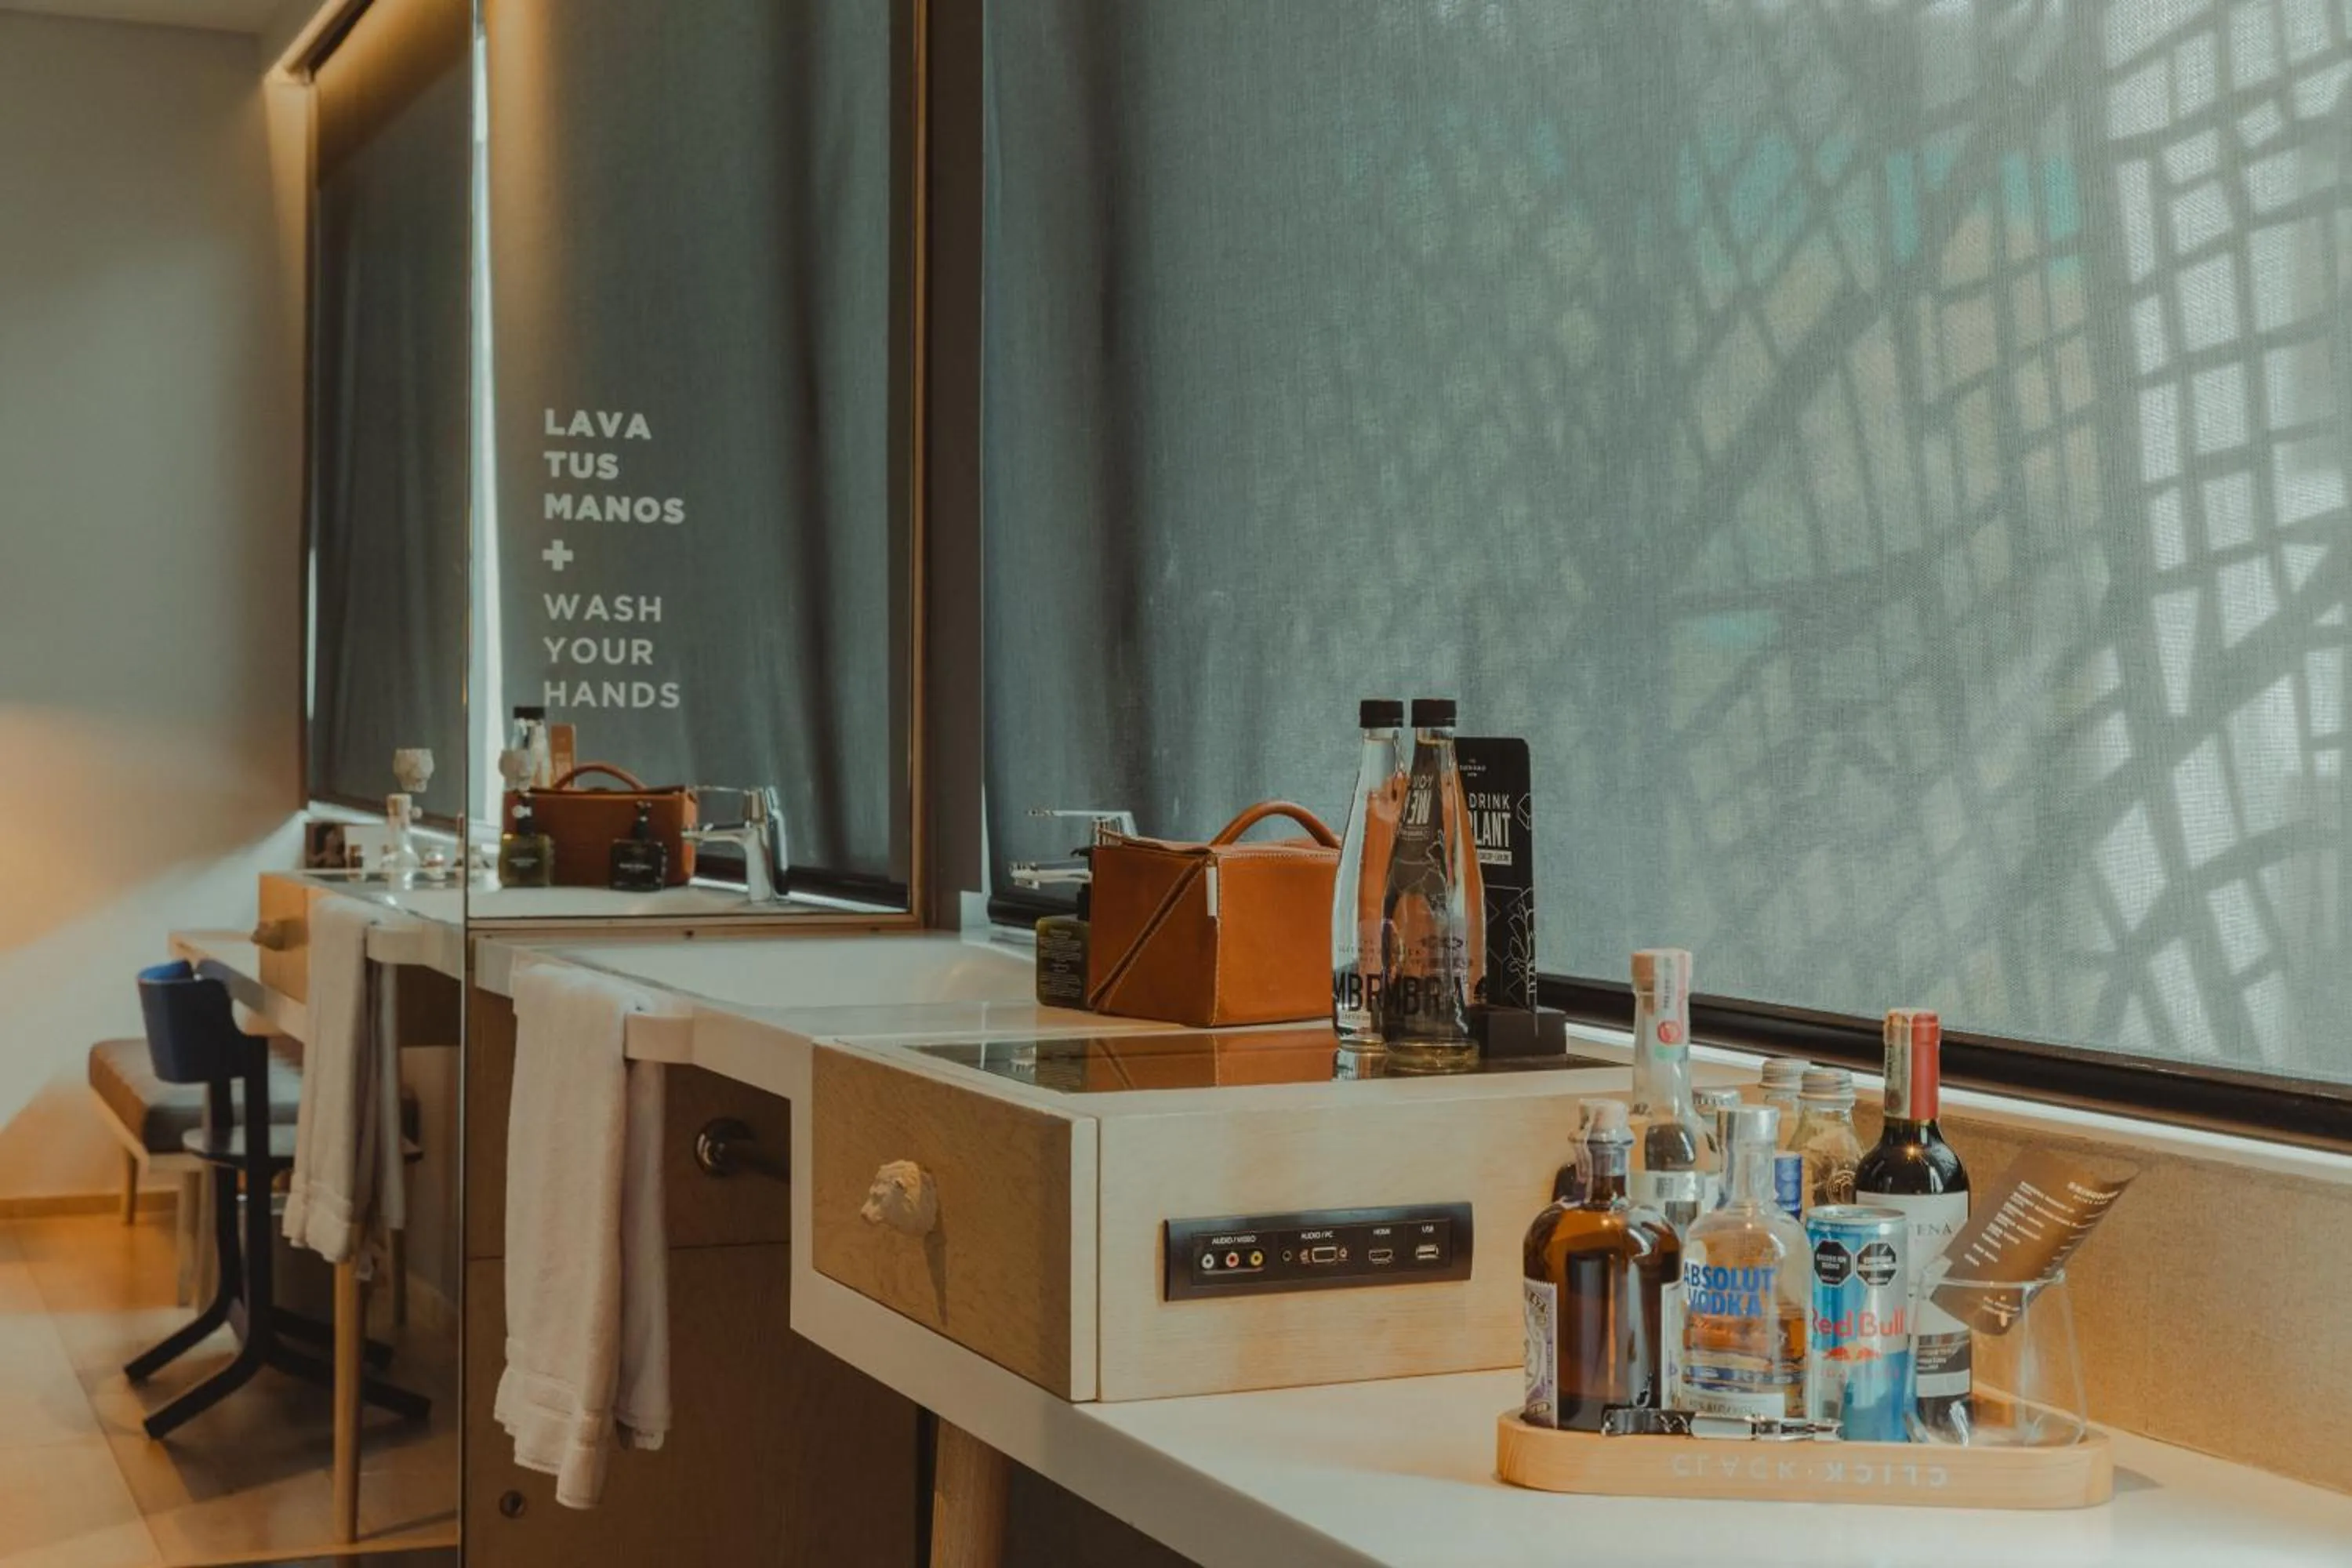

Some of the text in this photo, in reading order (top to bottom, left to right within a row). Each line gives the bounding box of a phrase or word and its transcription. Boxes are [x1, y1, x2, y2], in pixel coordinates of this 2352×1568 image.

[544, 408, 652, 441] LAVA
[543, 450, 619, 481] TUS
[544, 492, 686, 524] MANOS
[543, 593, 662, 622] WASH
[542, 636, 654, 665] YOUR
[543, 680, 681, 709] HANDS
[1468, 792, 1511, 811] DRINK
[1421, 1224, 1435, 1234] USB
[1683, 1260, 1777, 1292] ABSOLUT
[1687, 1288, 1762, 1317] VODKA
[1858, 1305, 1906, 1337] Bull
